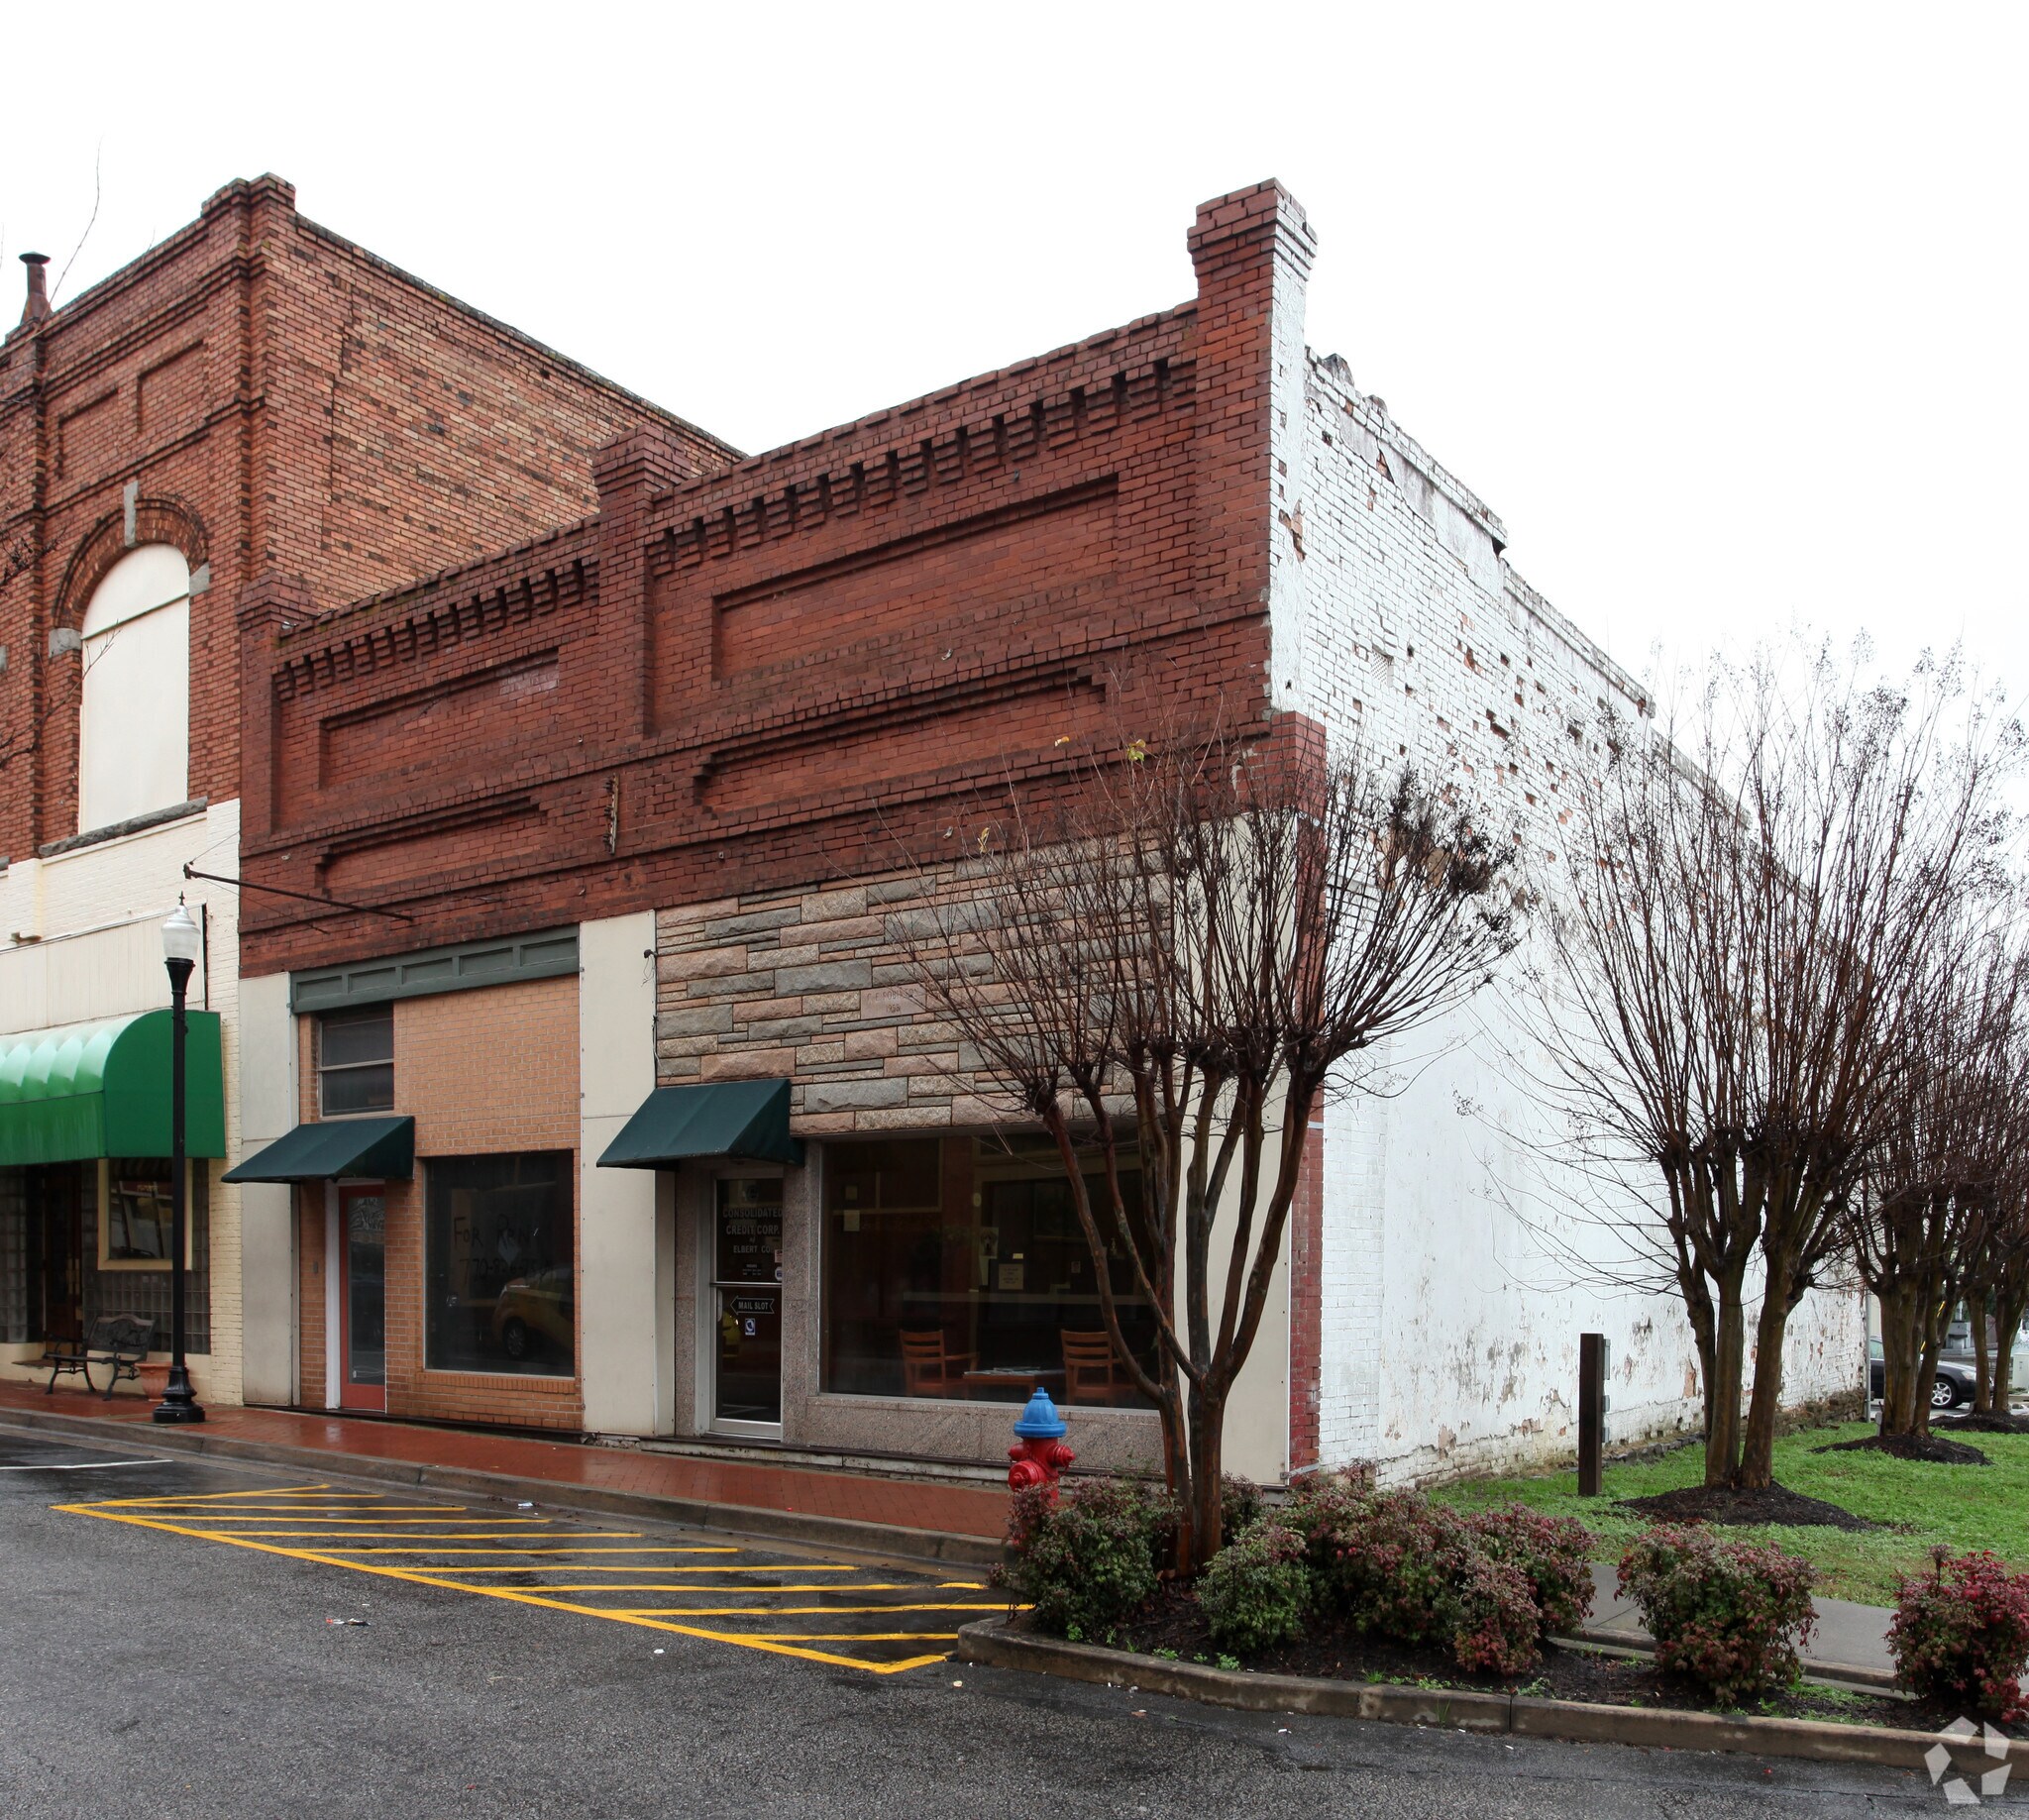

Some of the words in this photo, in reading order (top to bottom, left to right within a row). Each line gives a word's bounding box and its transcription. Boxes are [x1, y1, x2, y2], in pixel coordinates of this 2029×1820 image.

[722, 1207, 783, 1218] CONSOLIDATED
[726, 1225, 755, 1235] CREDIT
[756, 1225, 780, 1235] CORP.
[733, 1244, 758, 1253] ELBERT
[738, 1301, 753, 1310] MAIL
[754, 1301, 769, 1311] SLOT
